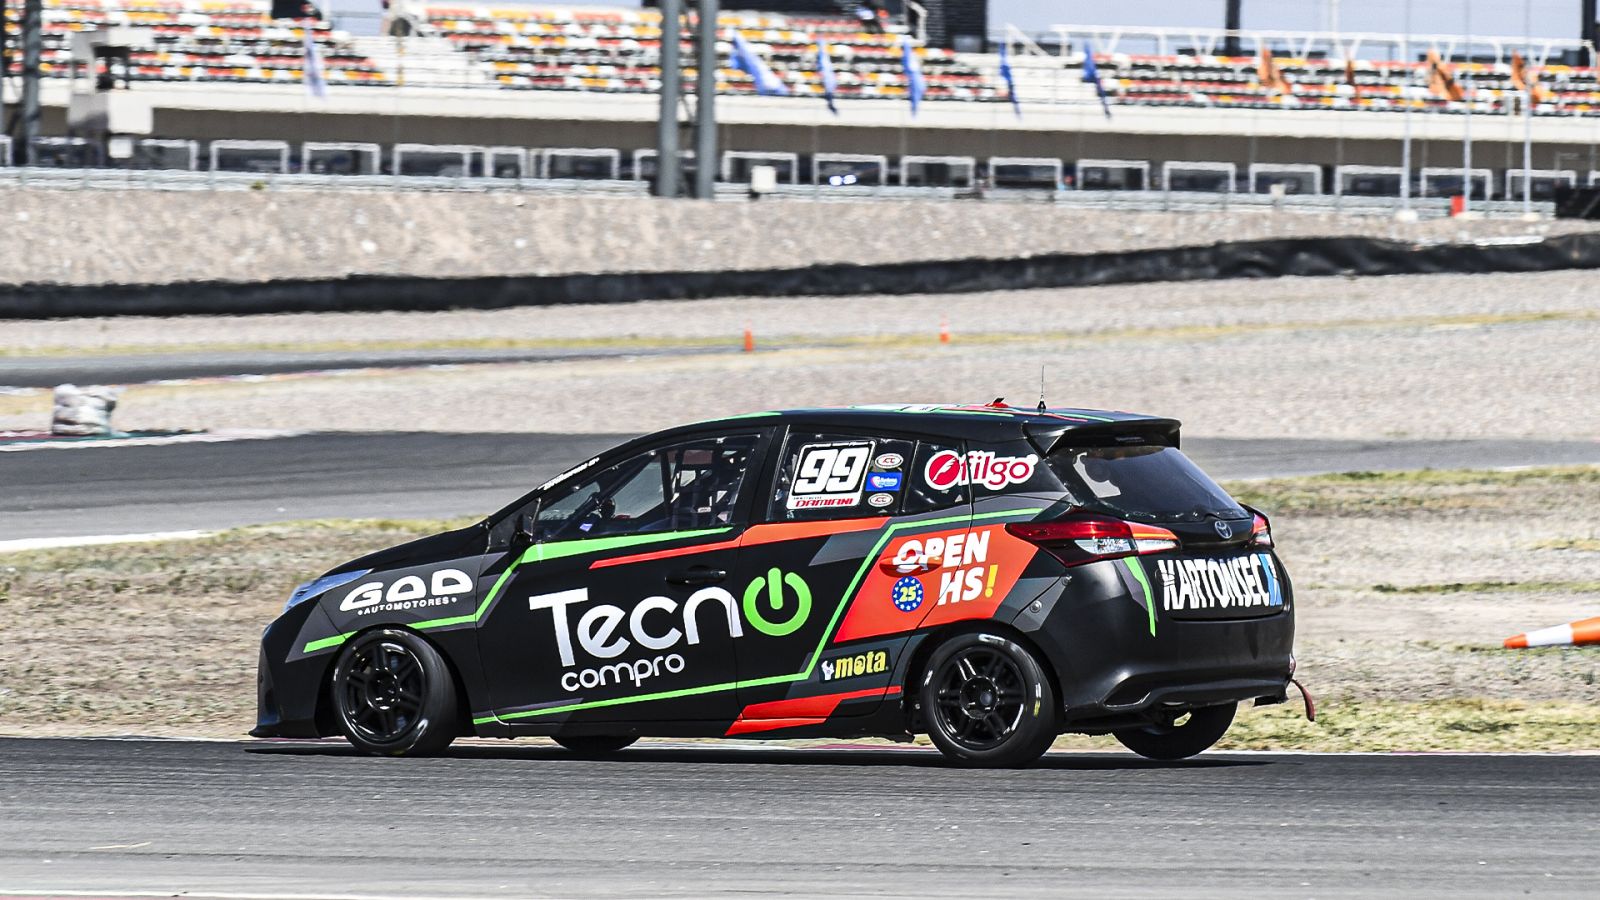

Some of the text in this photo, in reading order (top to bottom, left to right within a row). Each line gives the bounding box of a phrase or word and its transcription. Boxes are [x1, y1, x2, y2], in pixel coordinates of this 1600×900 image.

[794, 448, 869, 494] 99
[893, 530, 991, 574] OPEN
[363, 596, 450, 615] AUTOMOTORES
[899, 586, 917, 603] 25
[561, 653, 686, 692] compro
[834, 651, 887, 679] mota
